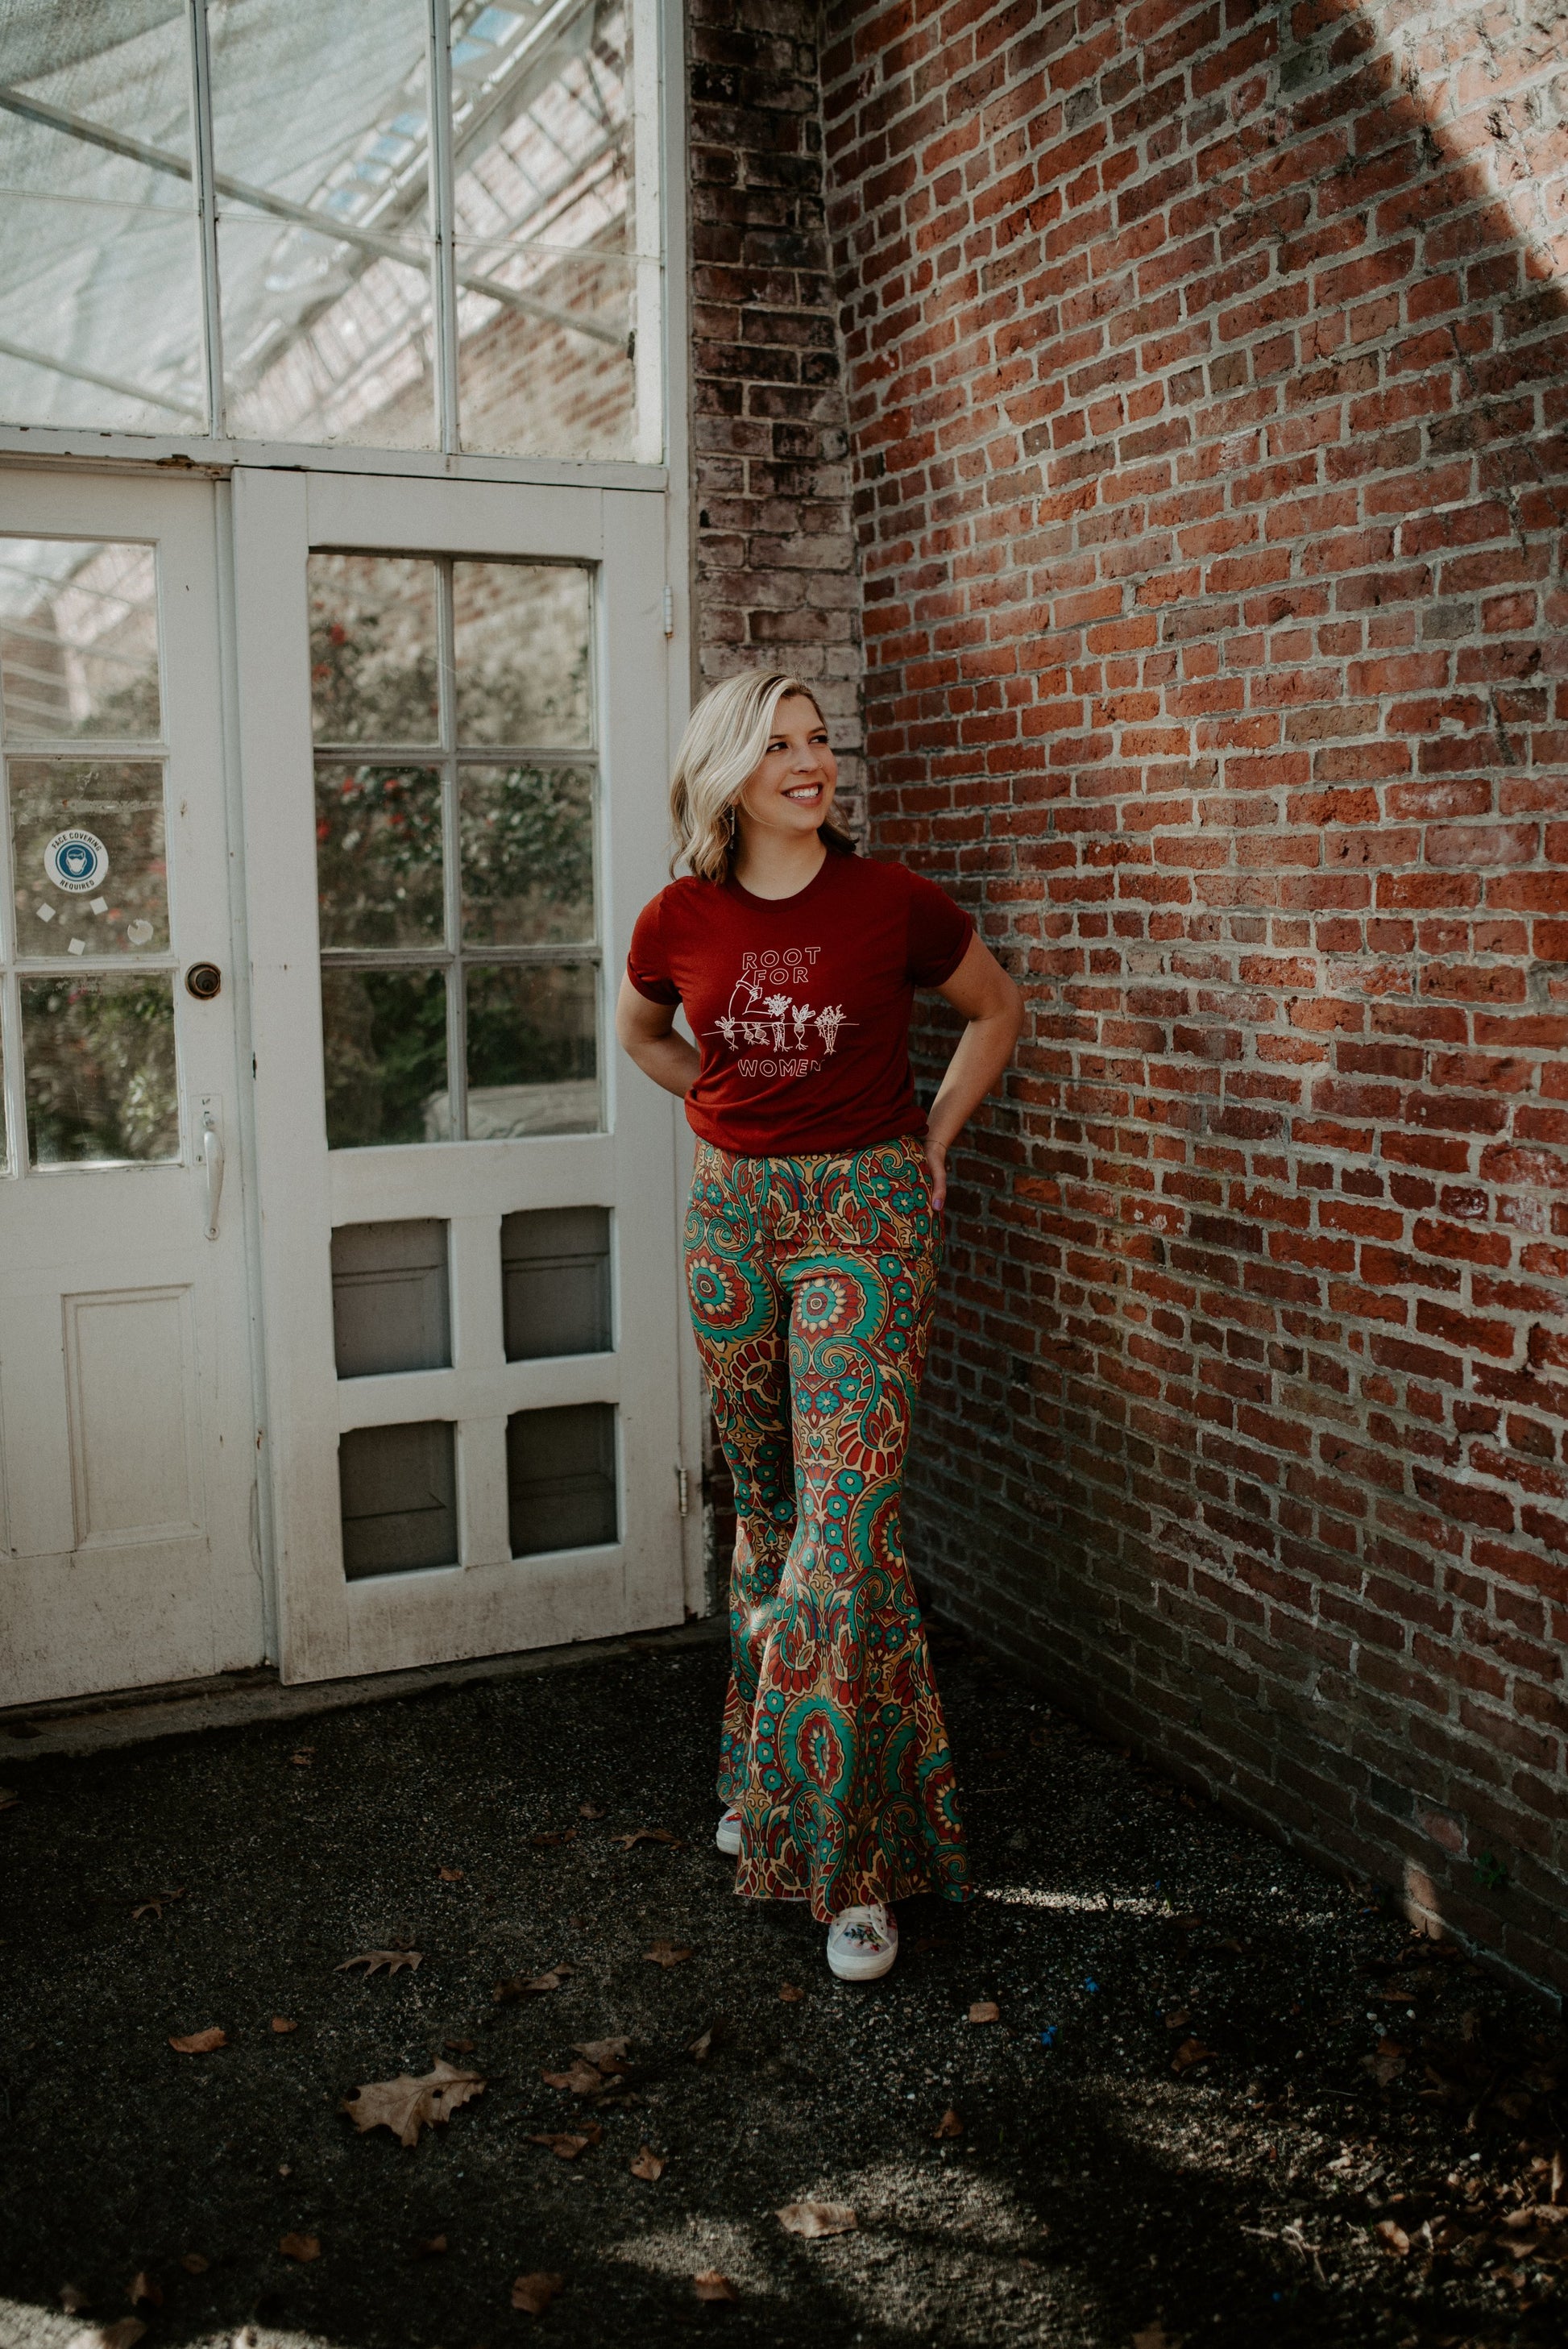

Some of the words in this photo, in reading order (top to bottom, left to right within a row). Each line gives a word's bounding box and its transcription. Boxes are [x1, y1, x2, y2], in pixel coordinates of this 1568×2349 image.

[52, 835, 68, 849] FACE
[69, 832, 102, 851] COVERING
[60, 879, 95, 890] REQUIRED
[742, 947, 821, 970] ROOT
[753, 966, 809, 987] FOR
[737, 1059, 825, 1077] WOMEN
